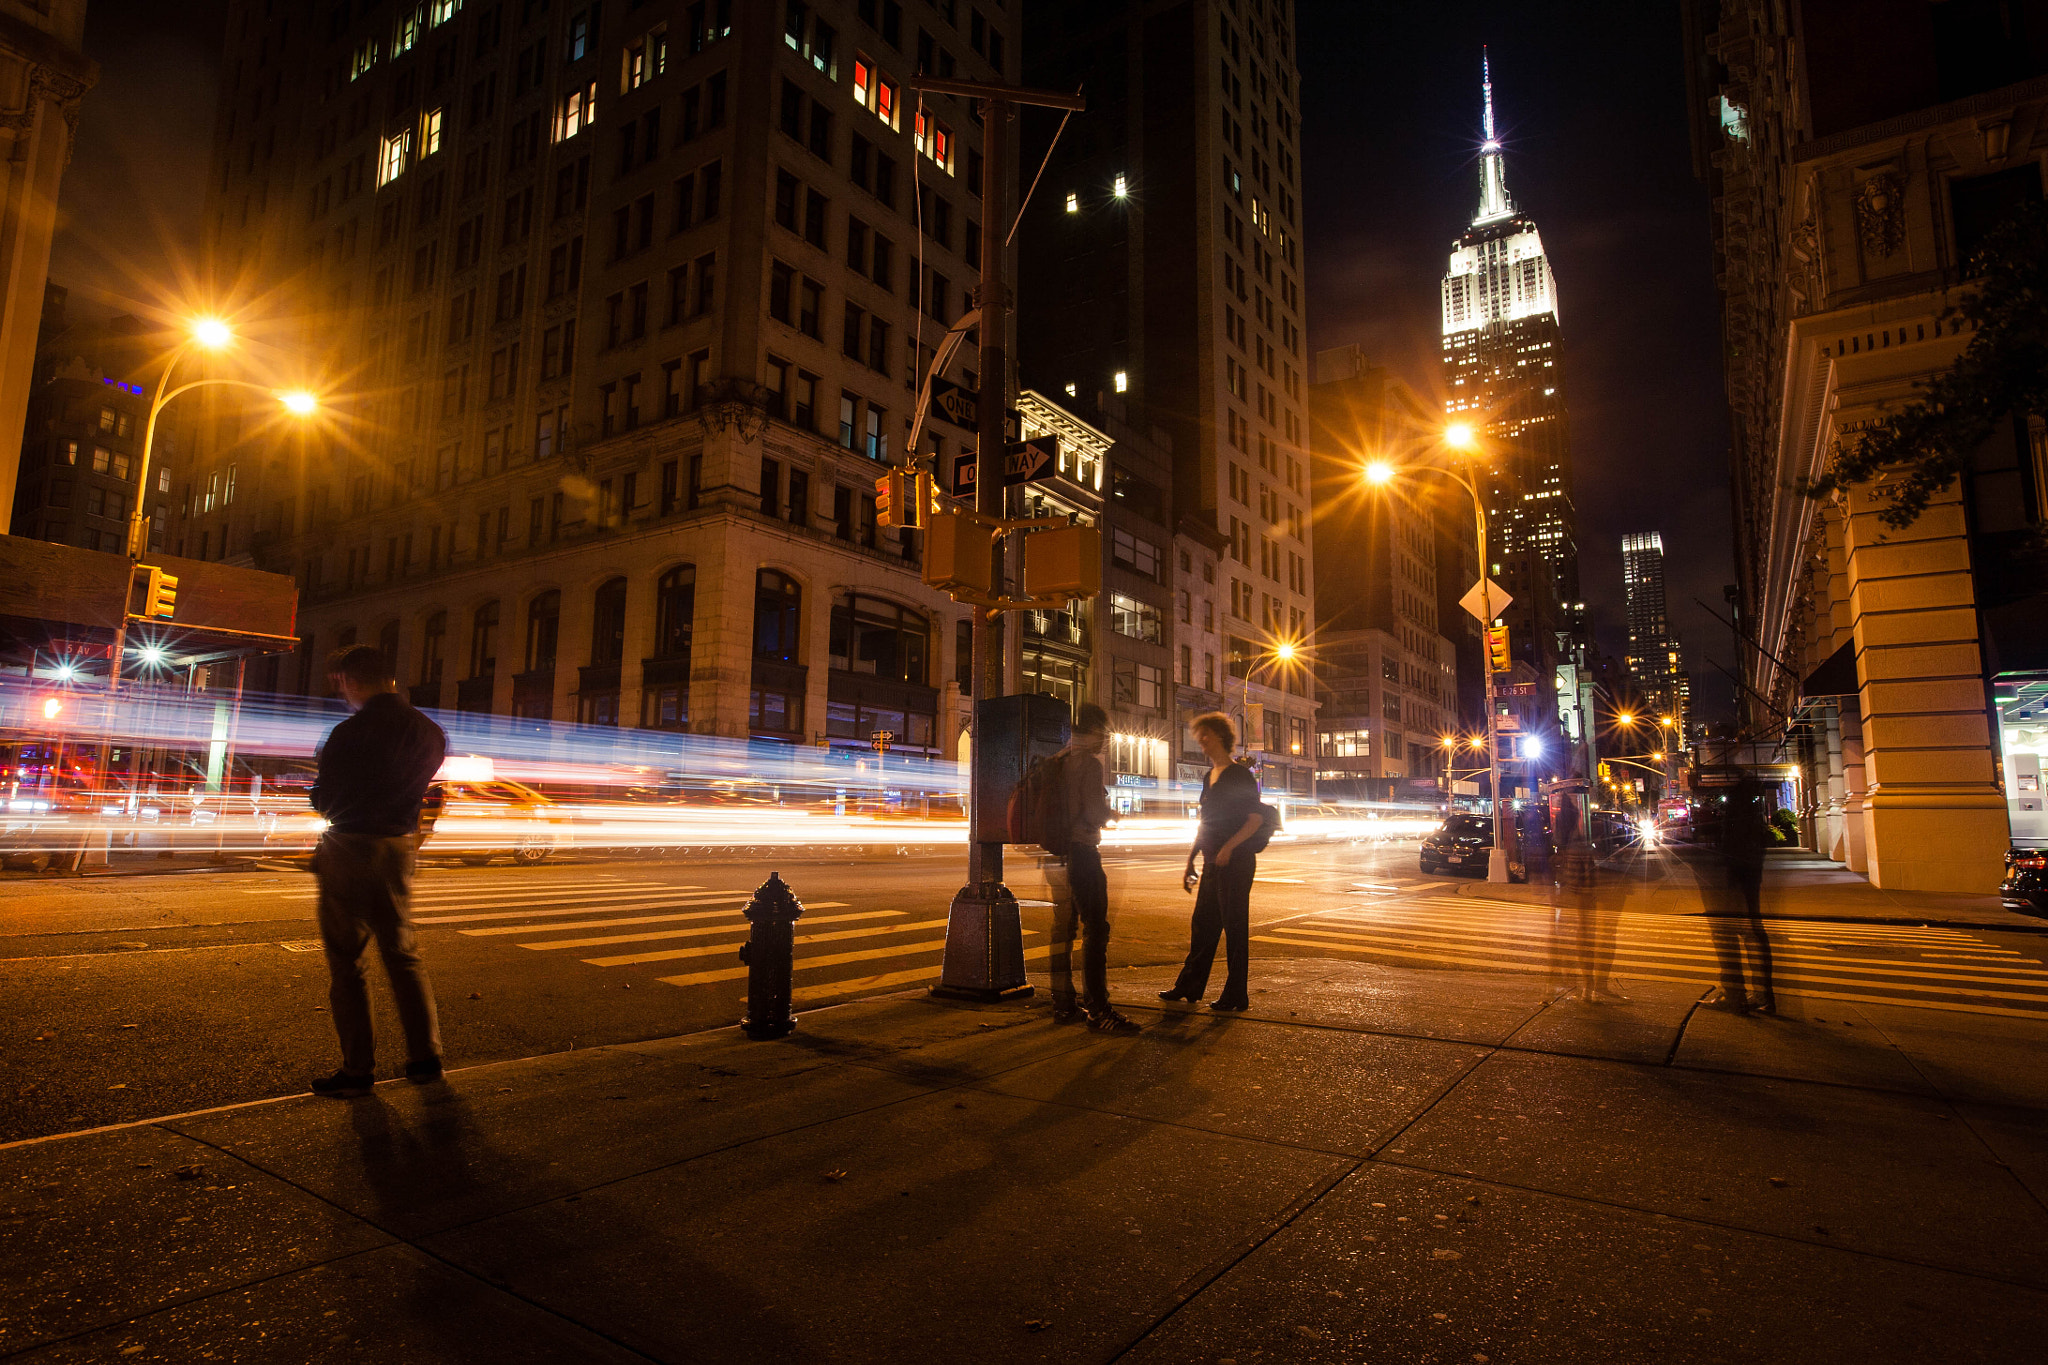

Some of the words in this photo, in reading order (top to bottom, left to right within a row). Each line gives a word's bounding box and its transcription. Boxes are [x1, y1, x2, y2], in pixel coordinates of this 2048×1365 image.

[946, 395, 973, 420] ONE
[1007, 452, 1039, 473] WAY
[77, 645, 90, 655] Av
[1502, 687, 1507, 696] E
[1509, 686, 1517, 695] 26
[1519, 686, 1527, 695] St
